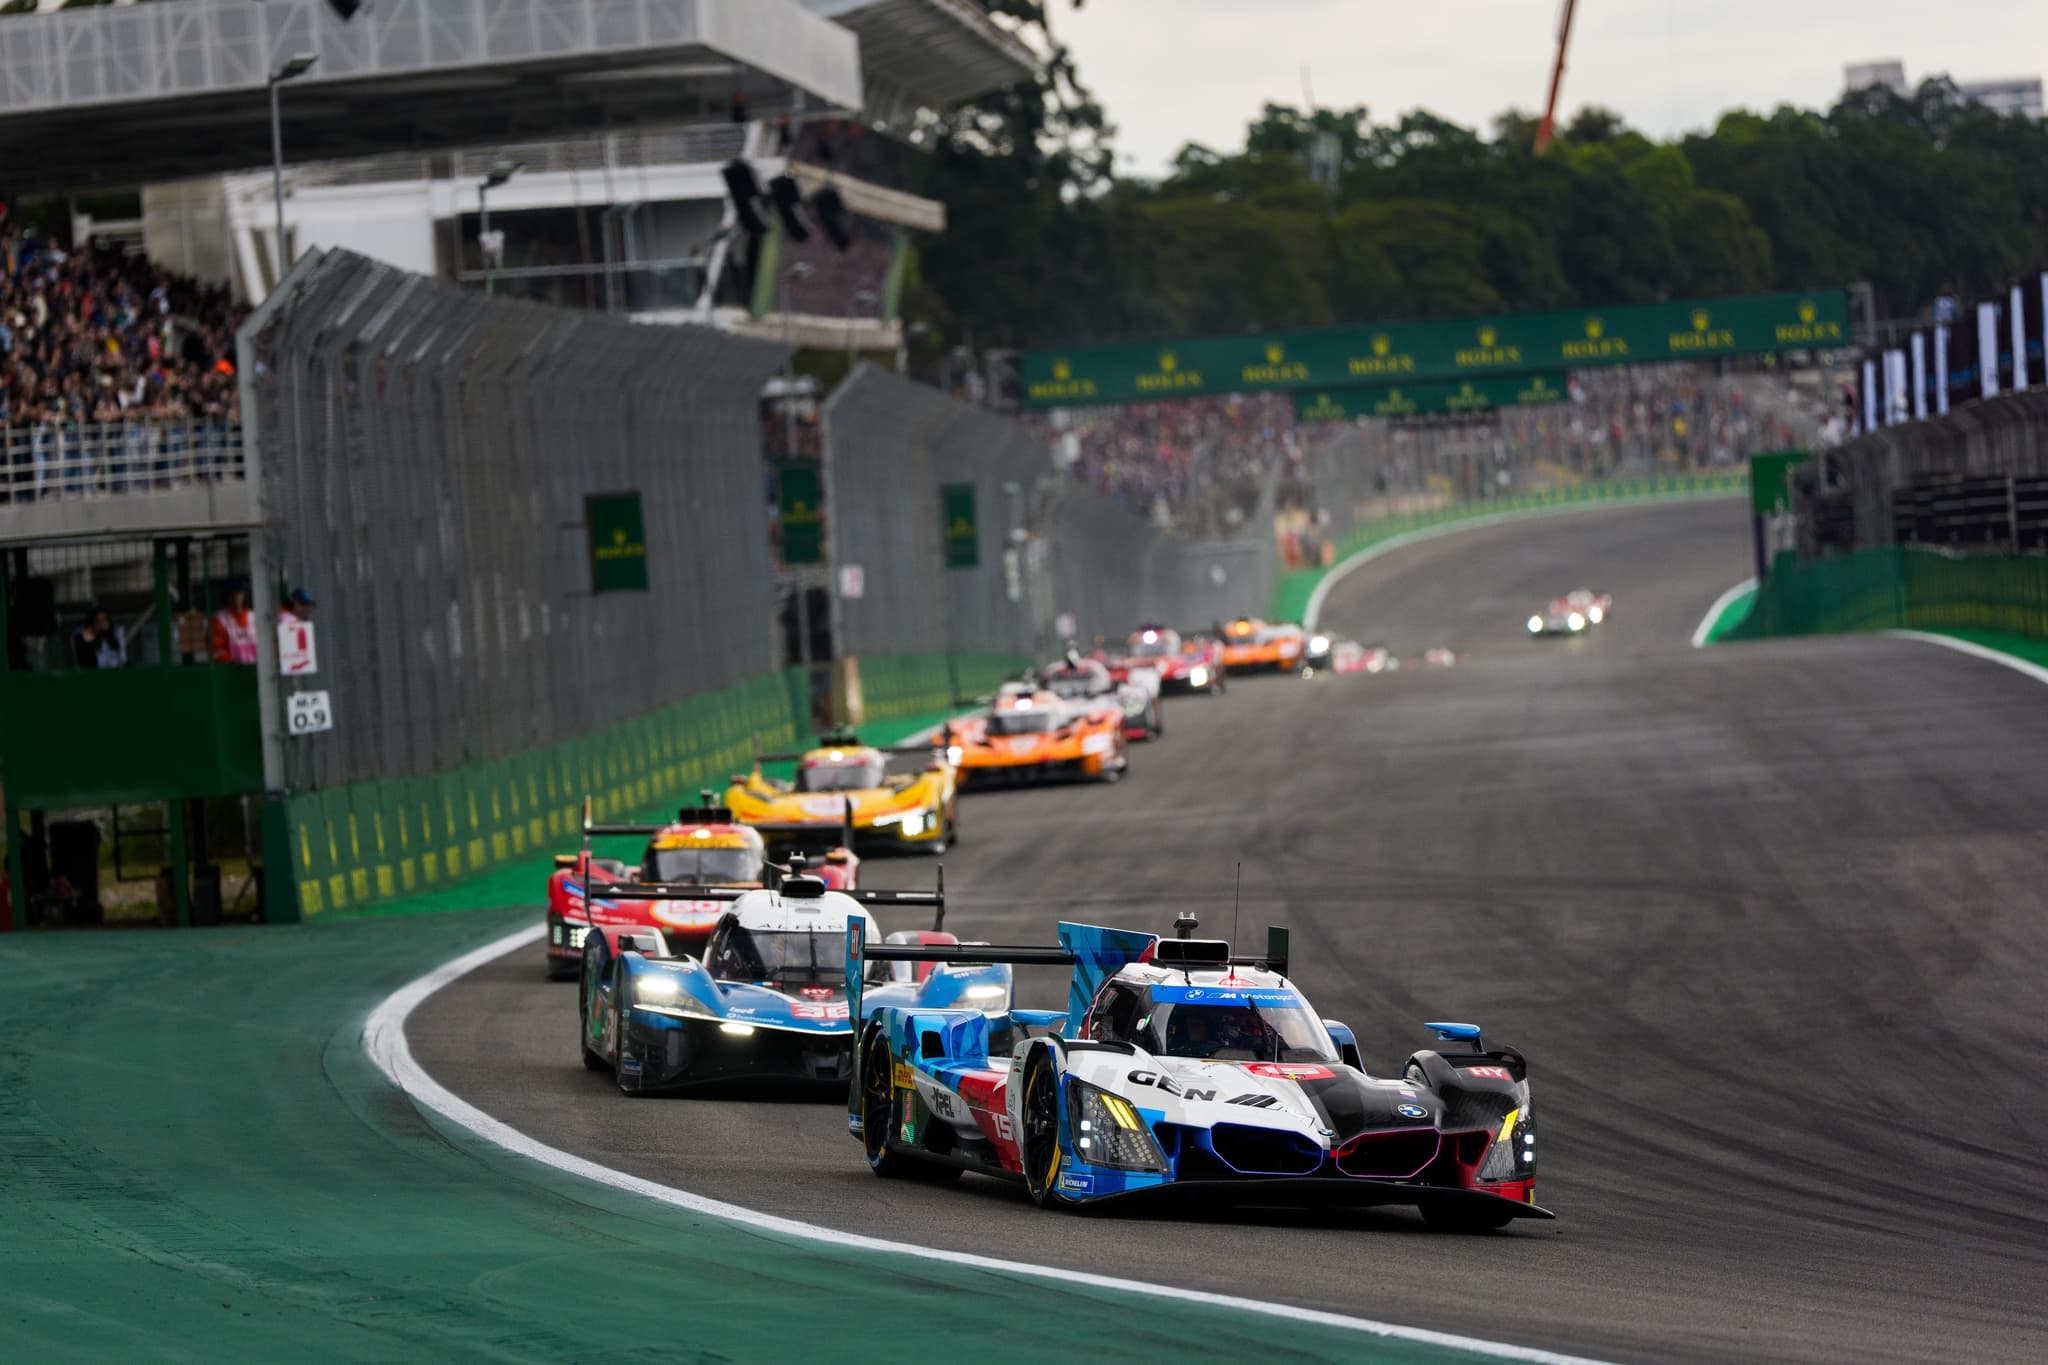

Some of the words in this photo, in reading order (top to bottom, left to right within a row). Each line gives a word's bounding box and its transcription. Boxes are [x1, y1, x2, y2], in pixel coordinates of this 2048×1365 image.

[1670, 329, 1732, 348] ROLEX
[1776, 320, 1839, 340] ROLEX
[1456, 347, 1519, 365] ROLEX
[1563, 338, 1626, 356] ROLEX
[1243, 363, 1307, 382] ROLEX
[1350, 355, 1413, 374] ROLEX
[1030, 380, 1095, 397] ROLEX
[1137, 371, 1201, 390] ROLEX
[293, 709, 327, 730] 0.9
[852, 929, 860, 954] HY
[802, 987, 831, 996] HY
[791, 1004, 848, 1018] 36
[1256, 1065, 1321, 1075] 15
[1471, 1066, 1503, 1077] HY
[1127, 1069, 1217, 1102] GEN
[932, 1086, 952, 1114] XPEL
[992, 1113, 1014, 1141] 15
